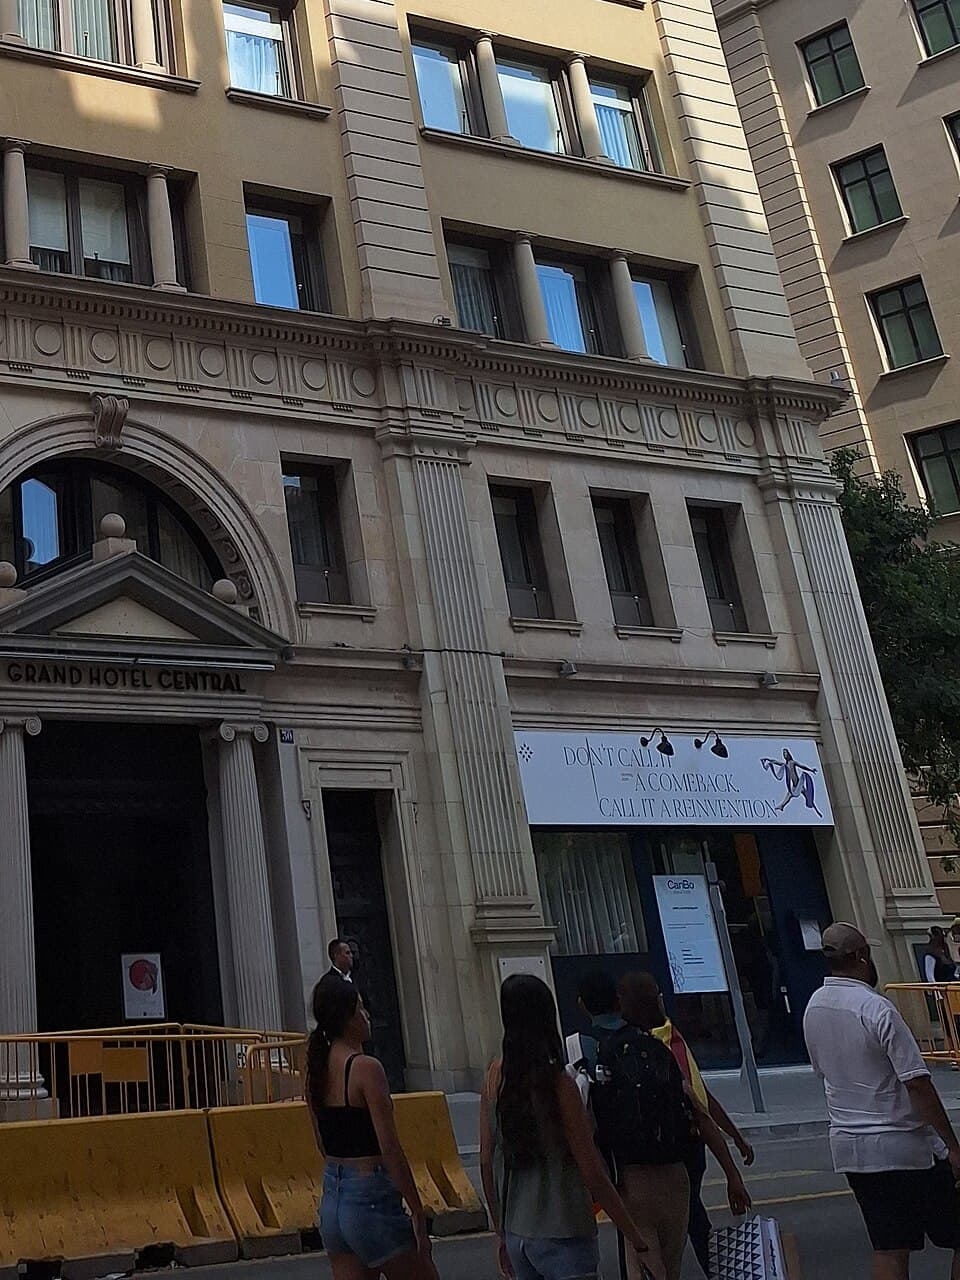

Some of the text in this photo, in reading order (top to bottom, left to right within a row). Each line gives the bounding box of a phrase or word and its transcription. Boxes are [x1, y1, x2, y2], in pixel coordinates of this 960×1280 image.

[7, 663, 247, 693] GRAND HOTEL CENTRAL
[563, 744, 613, 766] DON'T
[617, 748, 659, 768] CALL
[635, 774, 646, 792] A
[647, 773, 740, 793] COMEBACK.
[599, 797, 778, 818] CALL IT A REINVENTION
